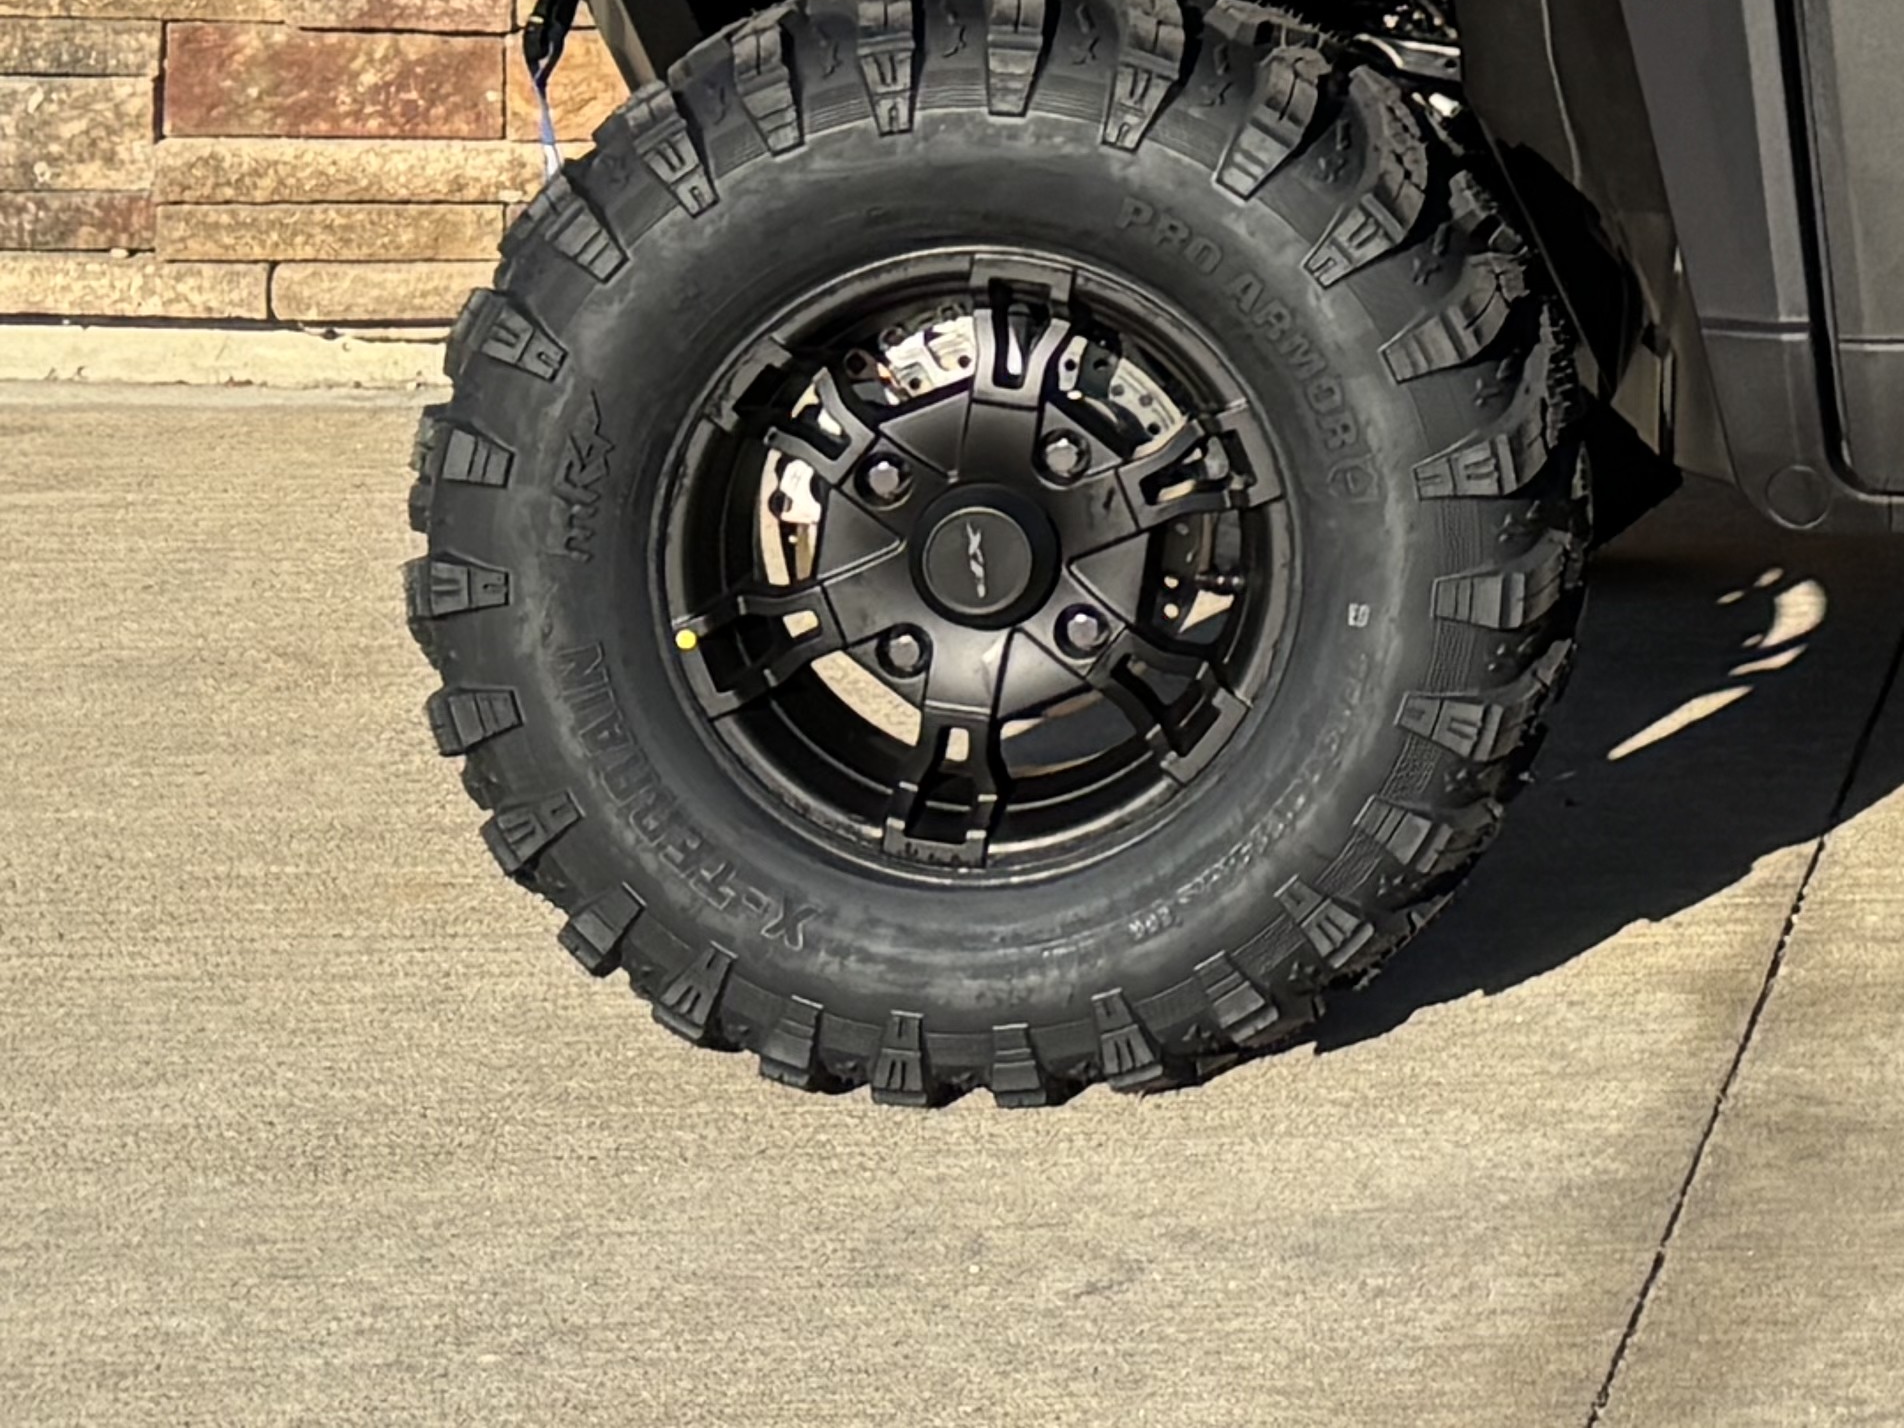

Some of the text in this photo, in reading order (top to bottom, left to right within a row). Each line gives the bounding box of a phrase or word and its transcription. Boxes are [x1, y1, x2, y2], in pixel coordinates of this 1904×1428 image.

[1117, 194, 1362, 454] PRO ARMOR
[553, 639, 822, 956] X-TERRAIN
